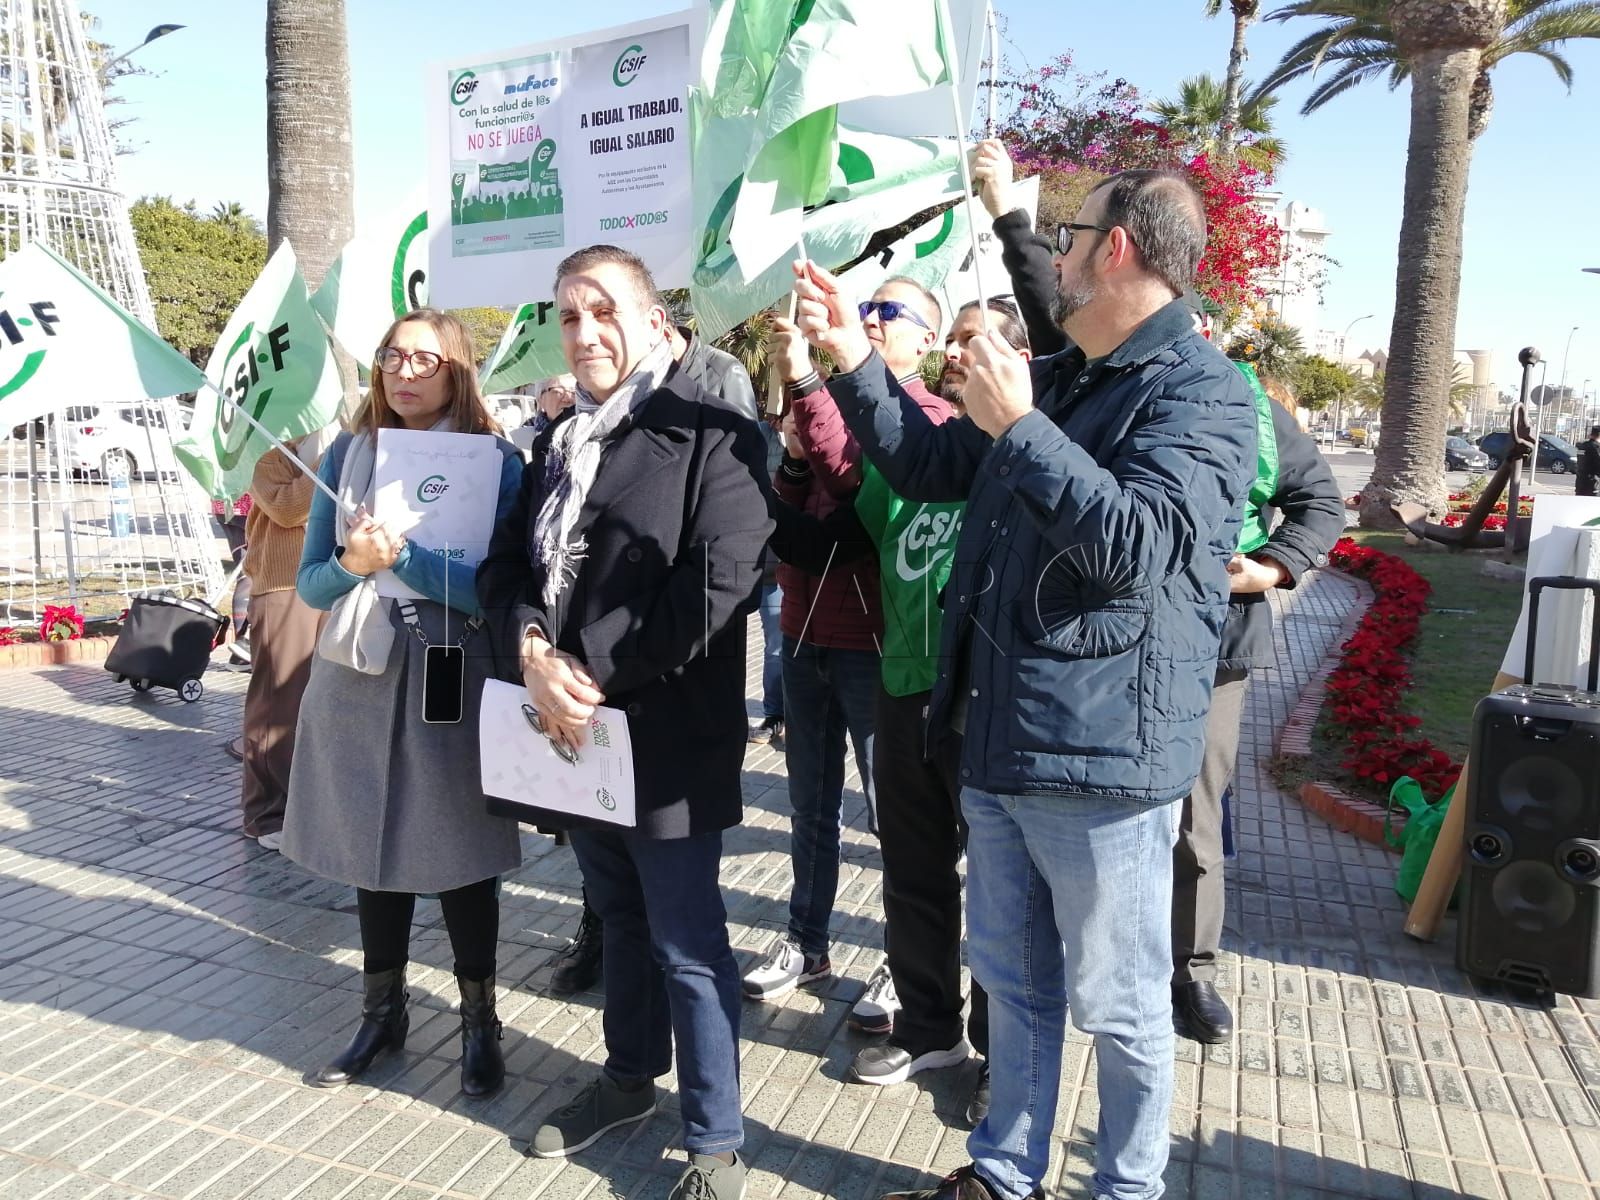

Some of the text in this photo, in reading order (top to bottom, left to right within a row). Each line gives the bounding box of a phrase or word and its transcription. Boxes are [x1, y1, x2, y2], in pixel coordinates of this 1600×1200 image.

[459, 95, 550, 118] Con la salud de l@s
[475, 111, 535, 128] funcionari@s
[580, 97, 683, 129] A IGUAL TRABAJO,
[468, 124, 542, 152] NO SE JUEGA
[590, 126, 675, 155] IGUAL SALARIO
